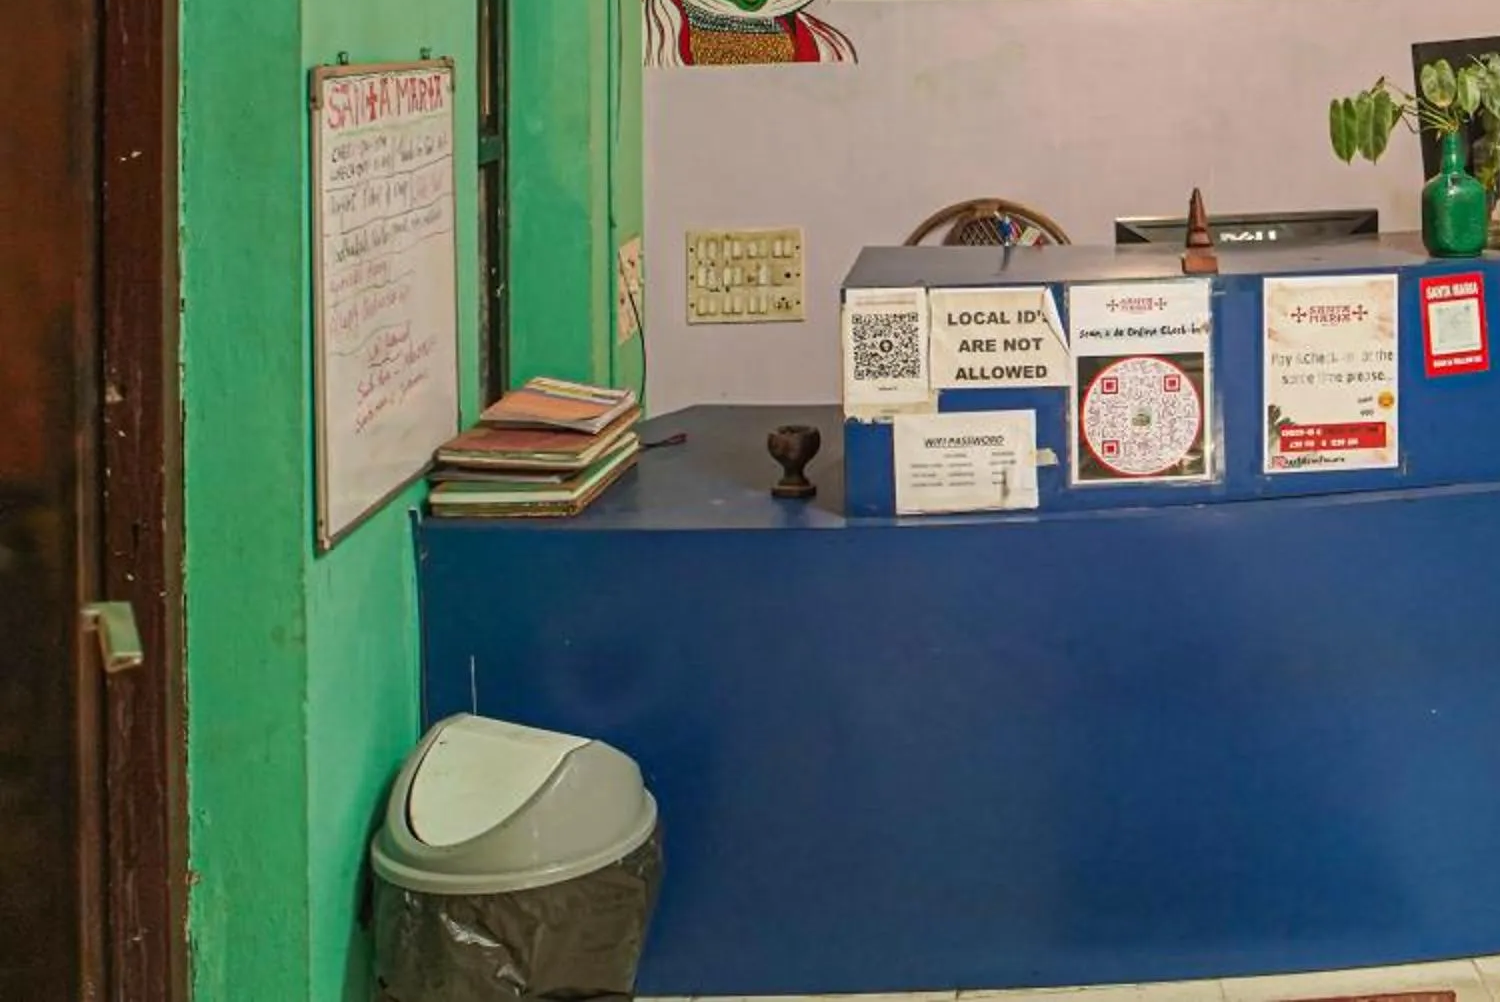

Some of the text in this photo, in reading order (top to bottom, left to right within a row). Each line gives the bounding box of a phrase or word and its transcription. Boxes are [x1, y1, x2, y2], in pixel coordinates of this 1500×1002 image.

[948, 310, 1011, 326] LOCAL
[958, 337, 1044, 353] ARE NOT
[955, 364, 1047, 381] ALLOWED
